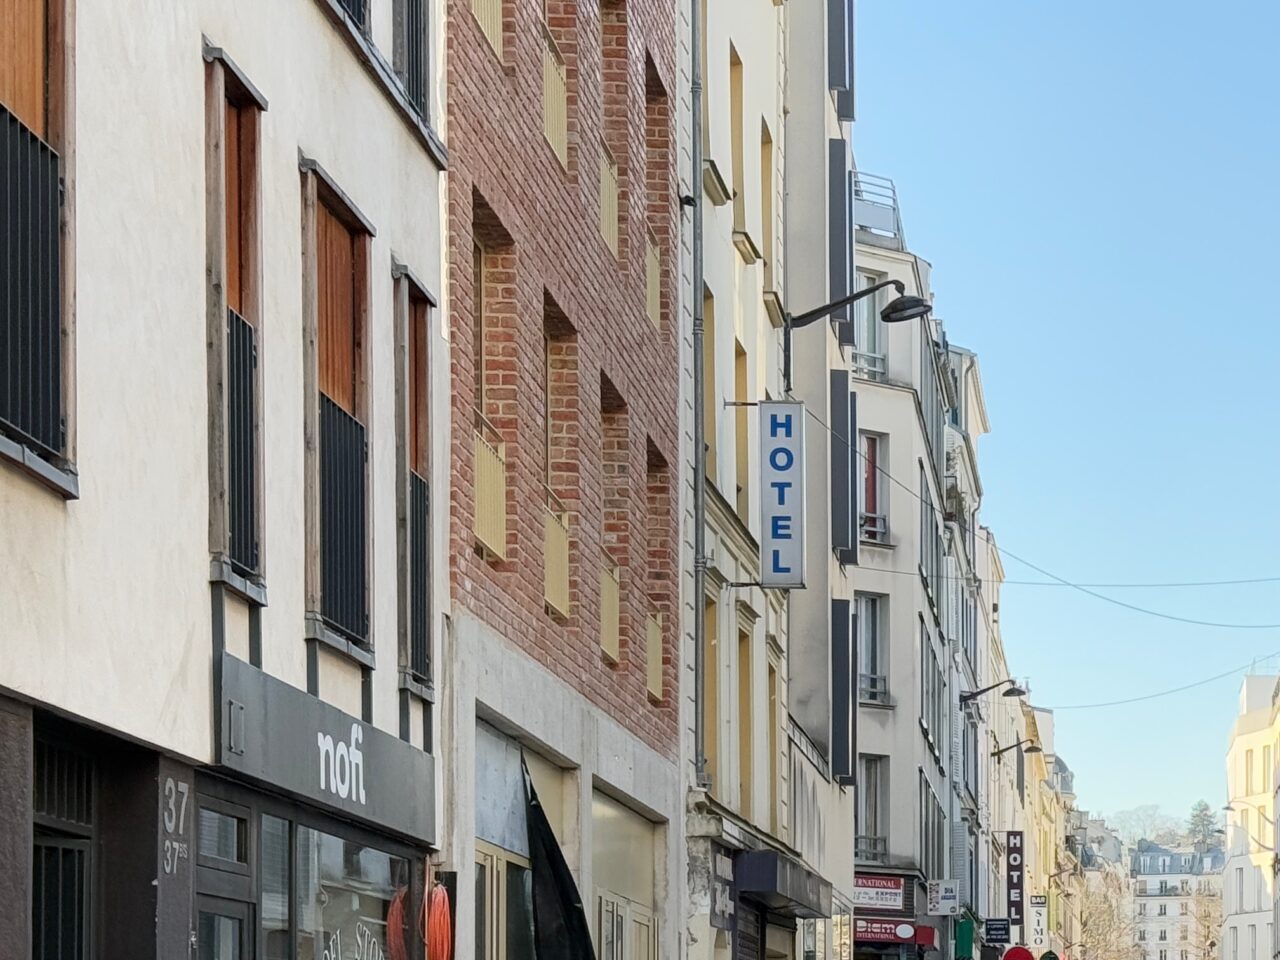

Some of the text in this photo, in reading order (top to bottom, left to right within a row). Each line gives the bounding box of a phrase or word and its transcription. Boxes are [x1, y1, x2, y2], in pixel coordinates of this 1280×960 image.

[769, 414, 794, 573] HOTEL
[317, 723, 366, 804] nofi
[164, 777, 189, 835] 37
[1009, 835, 1022, 919] HOTEL
[1033, 909, 1044, 946] SIMO
